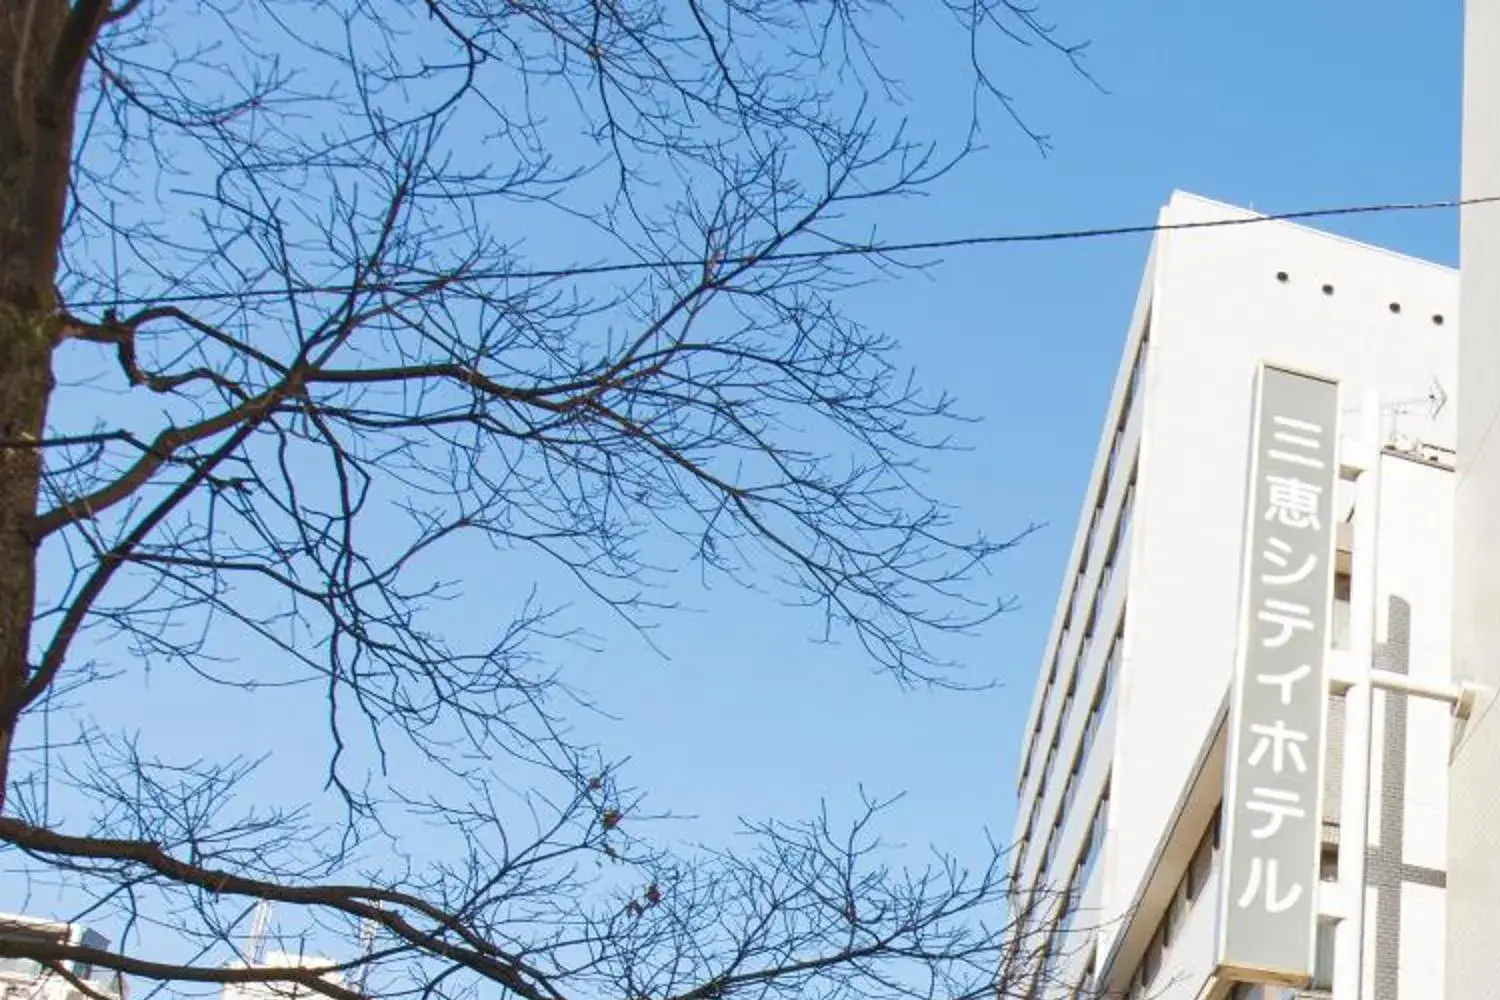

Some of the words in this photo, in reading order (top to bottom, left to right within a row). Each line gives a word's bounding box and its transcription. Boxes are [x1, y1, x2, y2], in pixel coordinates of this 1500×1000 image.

[1238, 416, 1325, 914] 三恵シティホテル
